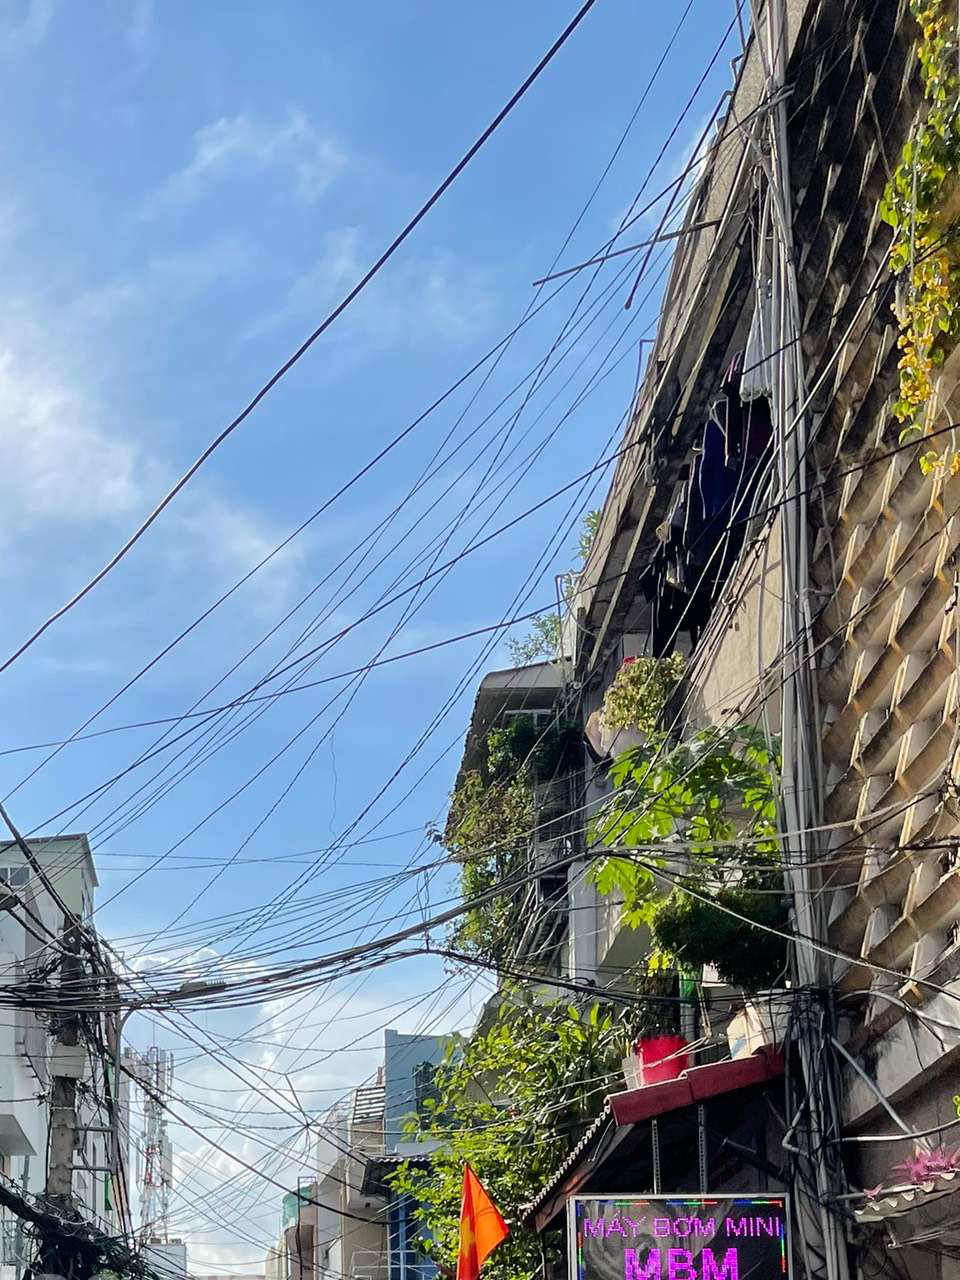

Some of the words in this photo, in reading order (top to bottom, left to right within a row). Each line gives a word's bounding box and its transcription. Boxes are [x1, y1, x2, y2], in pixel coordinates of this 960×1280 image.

[583, 1210, 647, 1238] MÁY
[653, 1214, 717, 1238] BƠM
[725, 1215, 781, 1238] MINI
